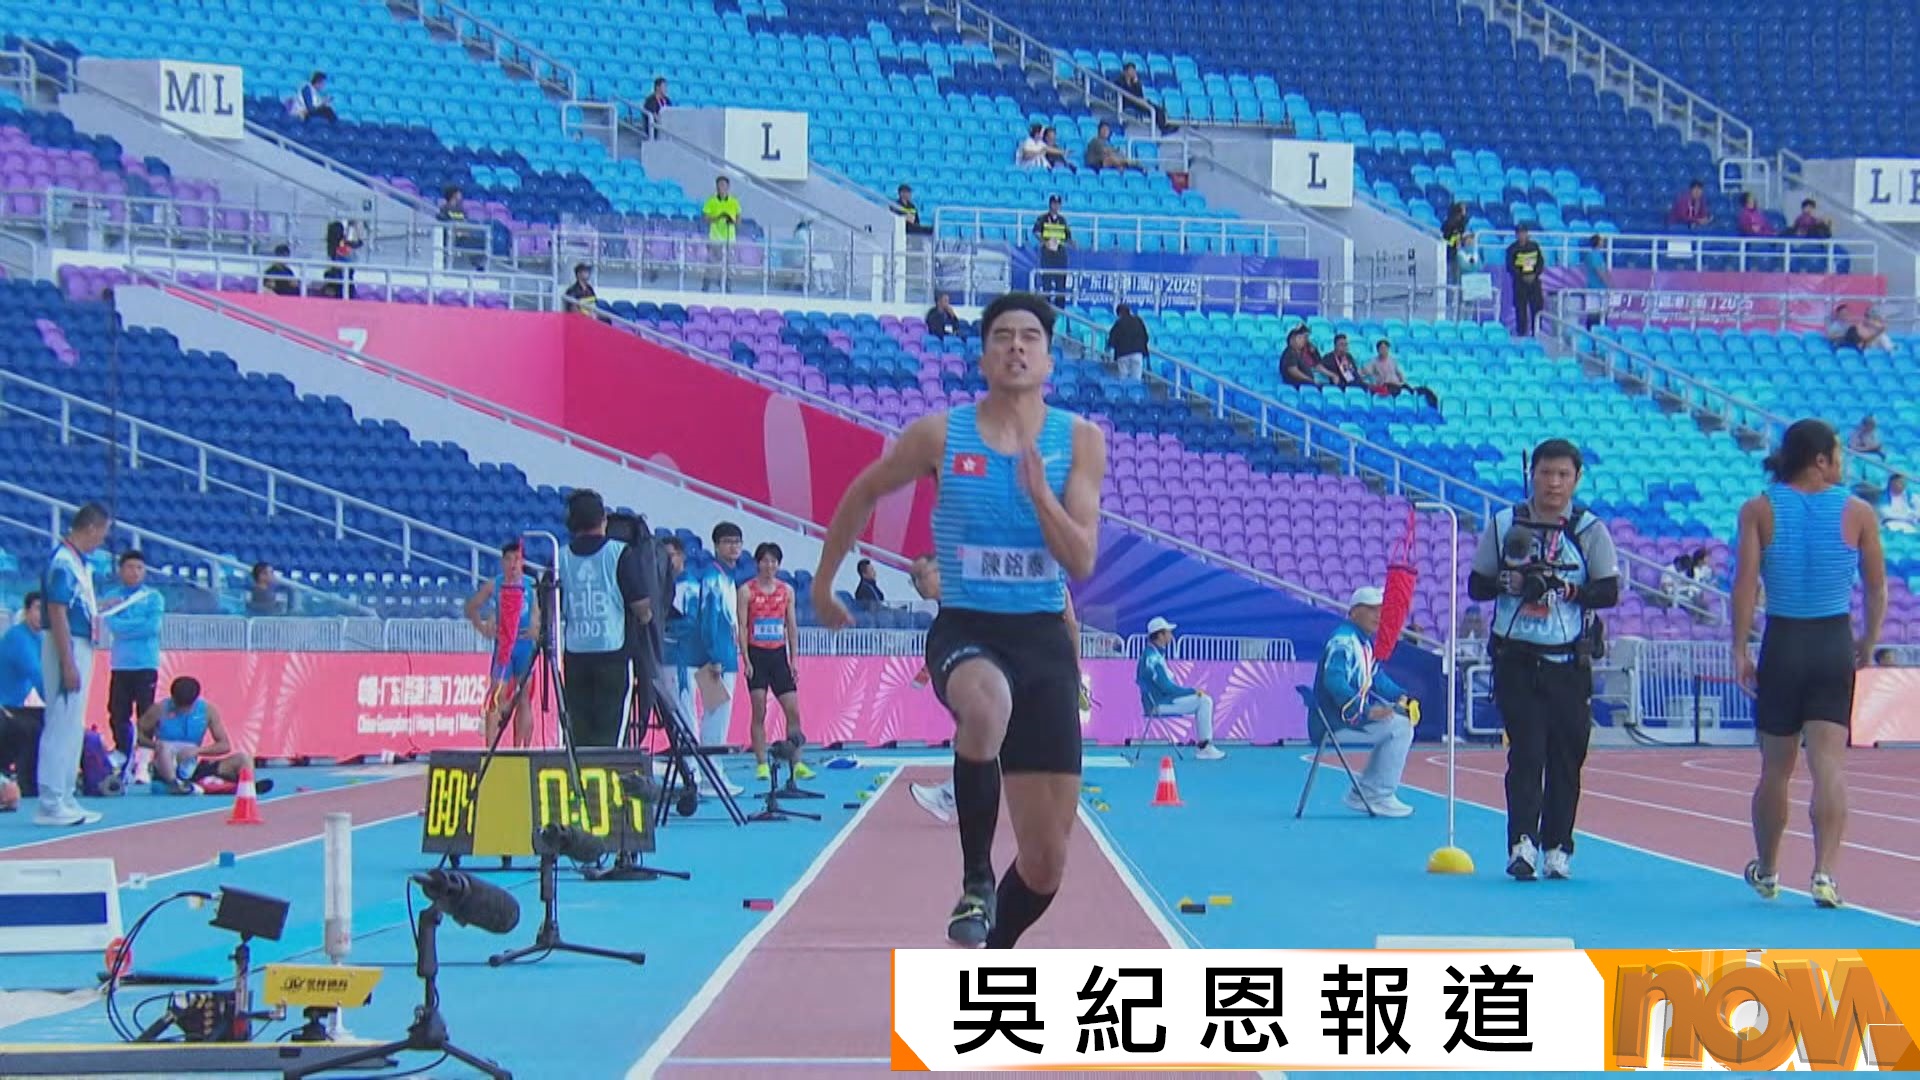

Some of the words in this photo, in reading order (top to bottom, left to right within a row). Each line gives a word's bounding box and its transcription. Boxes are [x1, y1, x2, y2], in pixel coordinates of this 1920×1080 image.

[761, 122, 781, 161] L
[1307, 152, 1327, 189] L
[453, 676, 486, 705] 2025
